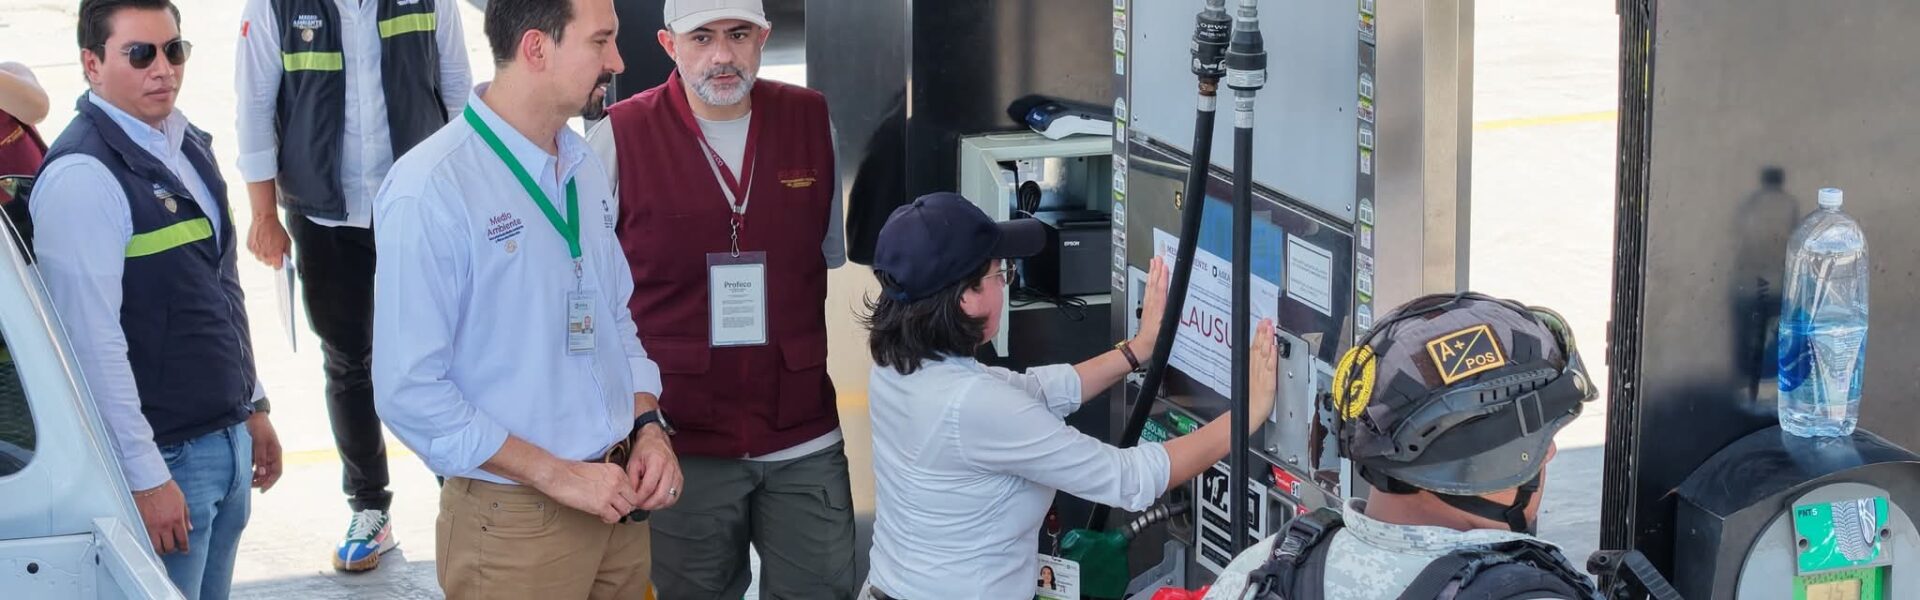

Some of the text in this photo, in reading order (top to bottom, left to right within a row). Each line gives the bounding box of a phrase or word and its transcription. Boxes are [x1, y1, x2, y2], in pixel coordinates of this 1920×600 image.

[487, 218, 522, 237] Ambiente
[489, 212, 512, 226] Medio
[723, 281, 752, 289] Profeco
[1180, 306, 1232, 349] LAUSU
[1440, 340, 1466, 362] A+
[1465, 352, 1496, 369] POS
